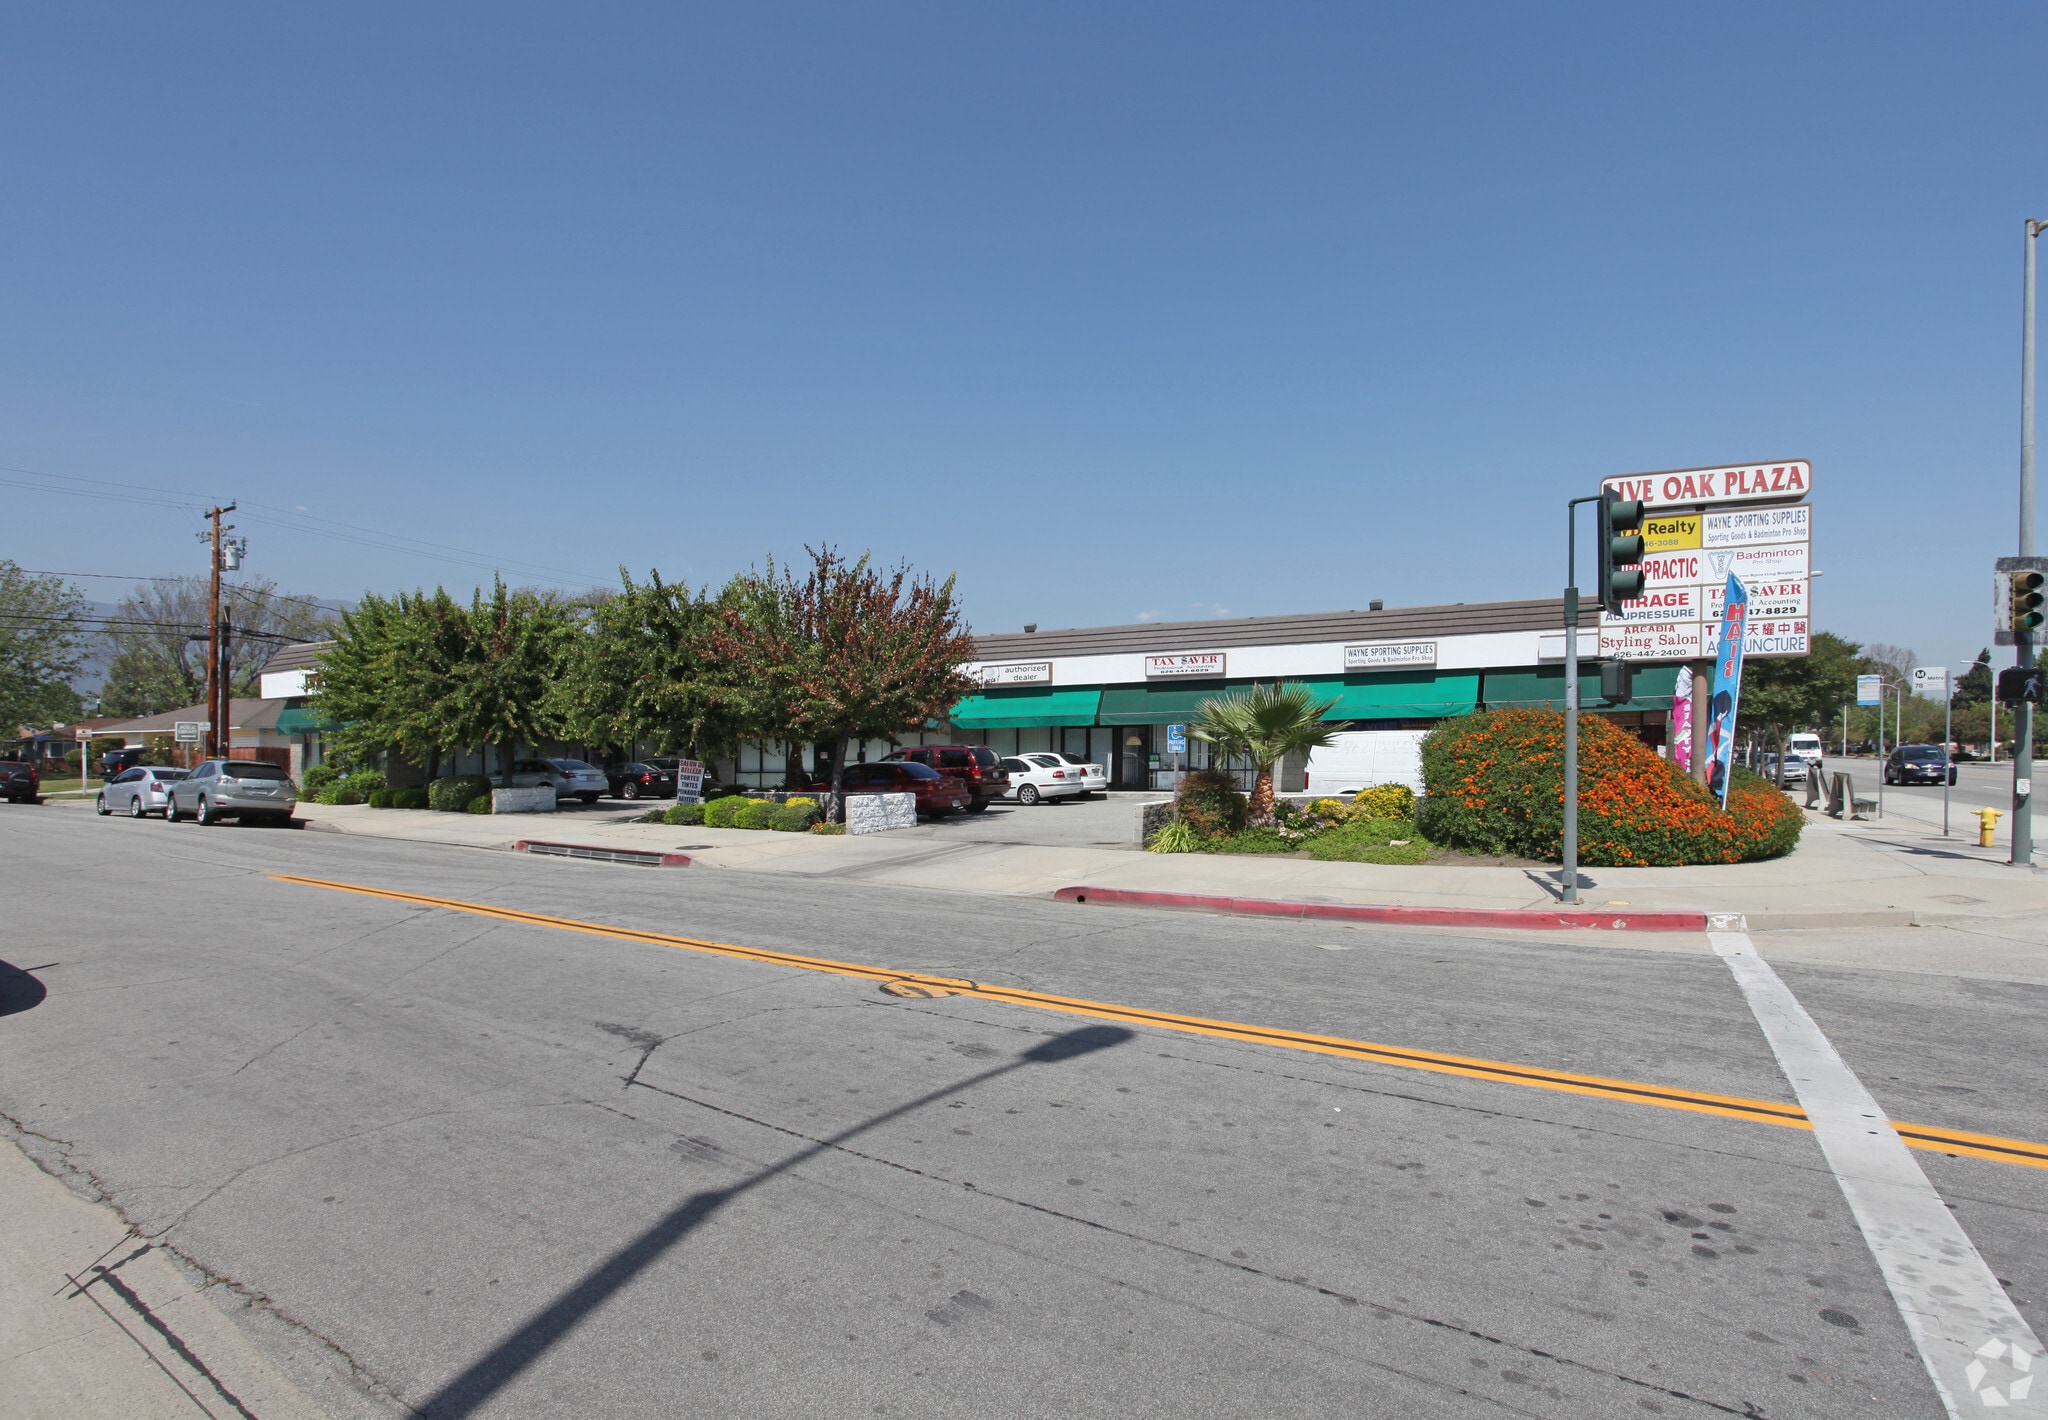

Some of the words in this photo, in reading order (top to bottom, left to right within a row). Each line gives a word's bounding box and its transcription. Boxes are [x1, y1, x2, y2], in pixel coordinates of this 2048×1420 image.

[1606, 479, 1653, 502] IVE
[1663, 473, 1715, 500] OAK
[1724, 466, 1804, 495] PLAZA
[1707, 516, 1731, 529] WAYNE
[1734, 513, 1769, 527] SPORTING
[1772, 510, 1806, 524] SUPPLIES
[1647, 520, 1696, 535] Realty
[1708, 533, 1729, 542] Sporting
[1731, 531, 1746, 540] Goods
[1754, 529, 1781, 538] Badminton
[1782, 528, 1791, 536] Pro
[1793, 526, 1806, 536] Shop
[1645, 539, 1678, 547] 46-3088
[1736, 548, 1803, 560] Badminton
[1622, 557, 1698, 580] PRACTIC
[1709, 588, 1726, 599] TA
[1759, 598, 1800, 607] Accounting
[1624, 624, 1675, 635] ARCADIA
[1601, 635, 1652, 650] Styling
[1659, 634, 1698, 646] Salon
[1348, 648, 1368, 657] WAYNE
[1371, 646, 1401, 656] SPORTING
[1403, 645, 1433, 655] SUPPLIES
[1614, 649, 1686, 658] 626-447-2400
[1152, 657, 1175, 666] TAX
[1004, 664, 1046, 673] authorized
